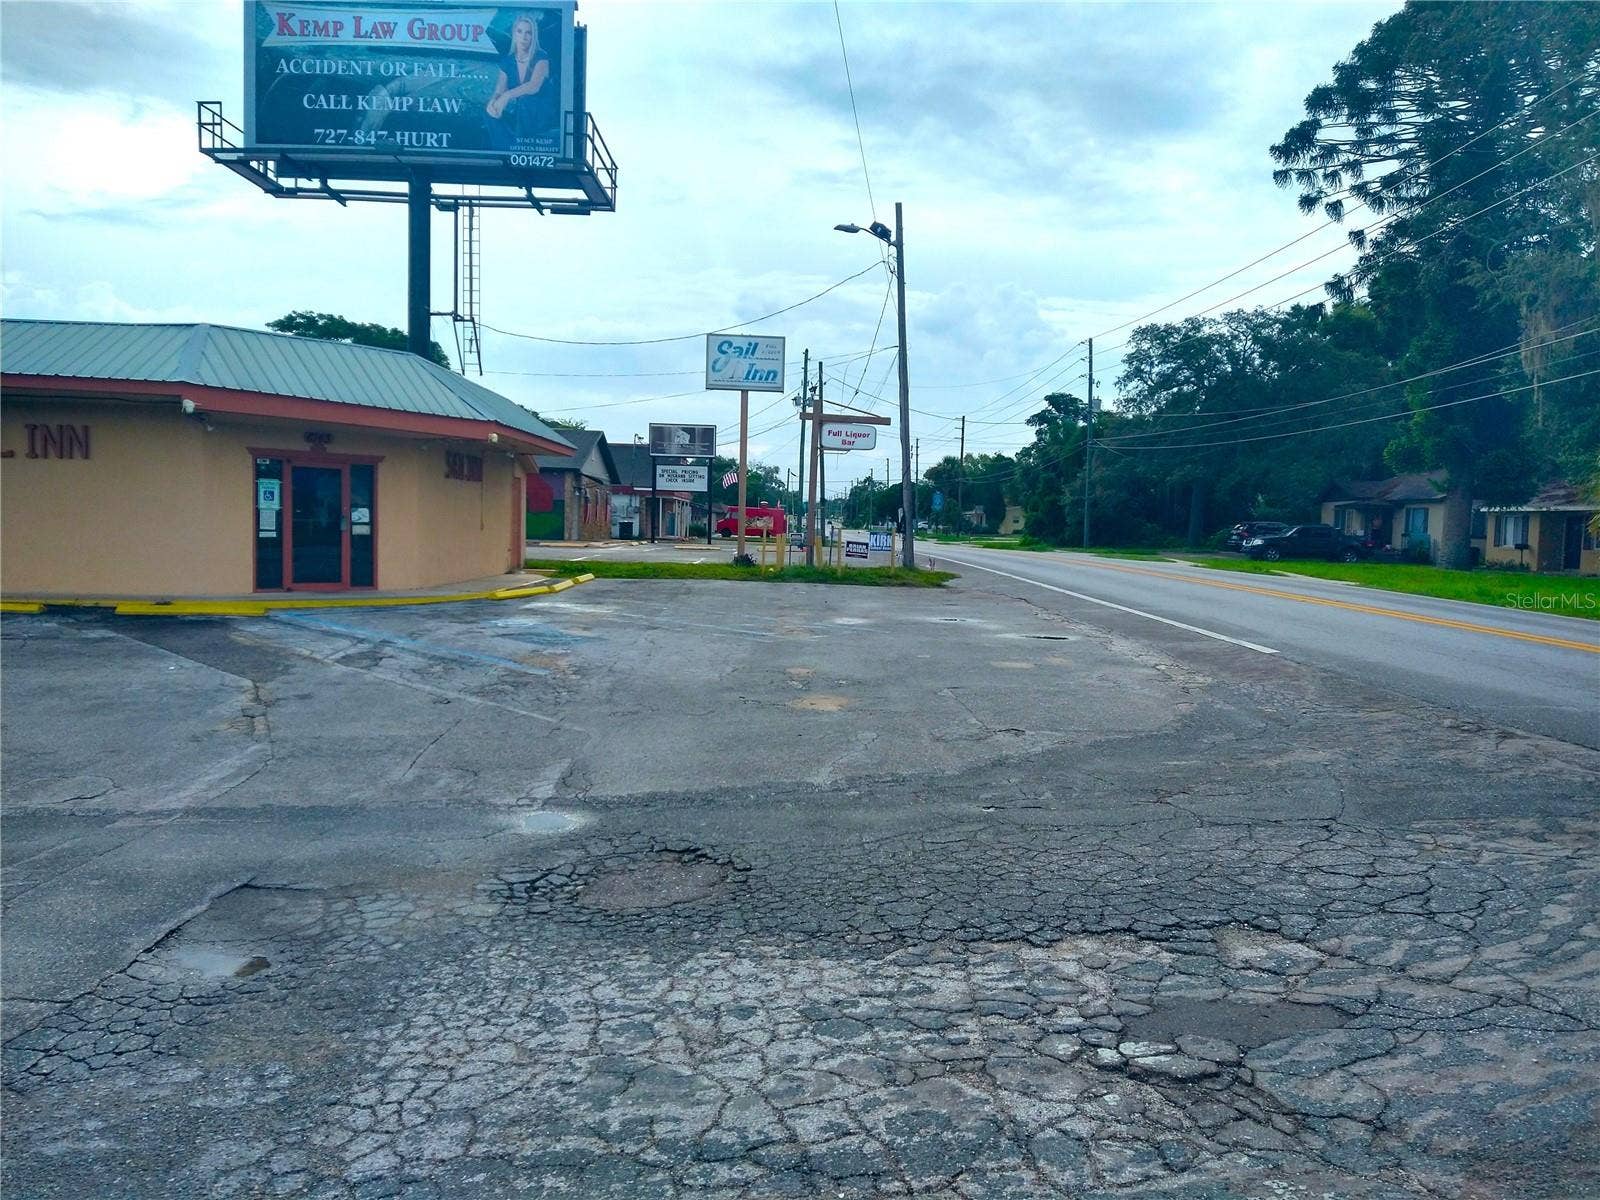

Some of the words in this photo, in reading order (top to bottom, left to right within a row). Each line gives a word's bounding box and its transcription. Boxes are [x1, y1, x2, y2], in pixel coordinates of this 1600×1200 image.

[275, 12, 344, 37] KEMP
[352, 15, 398, 39] LAW
[407, 17, 485, 42] GROUP
[276, 58, 375, 76] ACCIDENT
[379, 61, 407, 77] OR
[303, 94, 352, 110] CALL
[357, 95, 413, 111] KEMP
[418, 97, 463, 113] LAW
[313, 129, 452, 148] 727-847-HURT
[510, 154, 554, 168] 001472
[712, 340, 759, 373] Sail
[743, 363, 778, 381] Inn
[24, 424, 90, 460] INN
[827, 429, 843, 437] Full
[845, 431, 871, 439] Liquor
